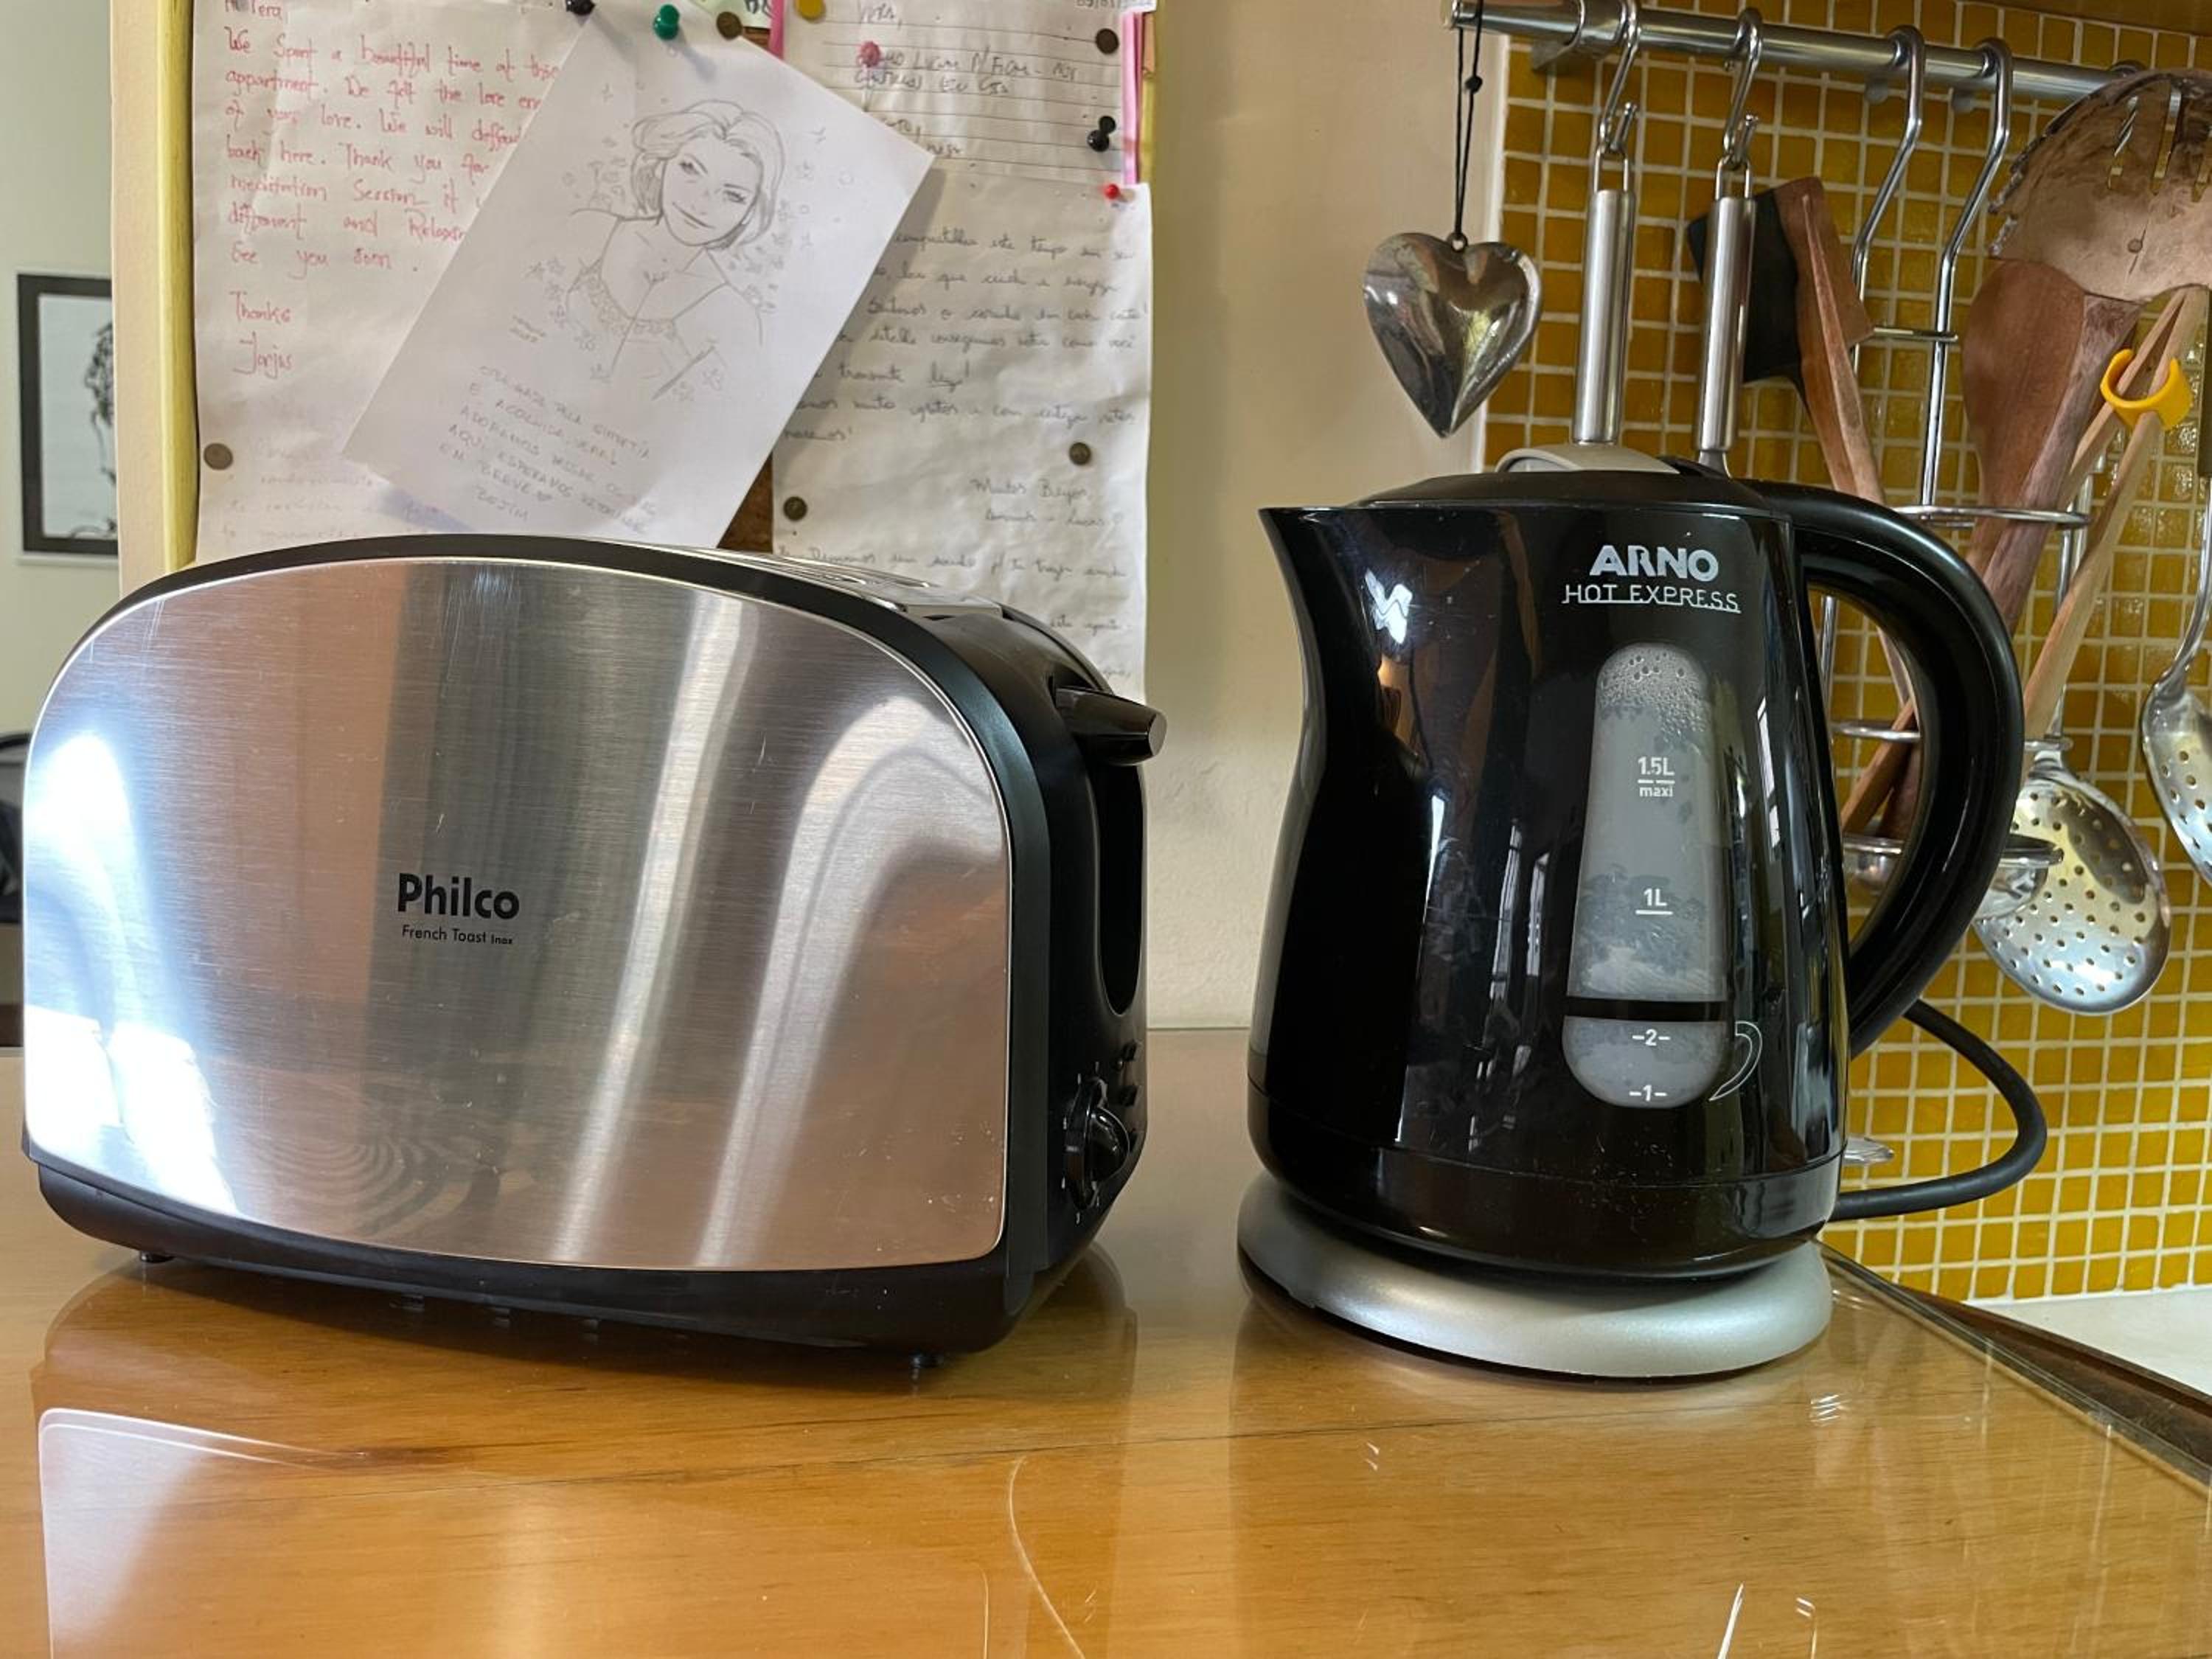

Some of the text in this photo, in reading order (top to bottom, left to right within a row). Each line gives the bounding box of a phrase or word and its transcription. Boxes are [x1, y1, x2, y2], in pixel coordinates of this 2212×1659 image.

[224, 26, 251, 54] We
[448, 46, 481, 75] time
[435, 79, 463, 103] the
[379, 108, 407, 133] We
[338, 142, 394, 170] Thank
[410, 153, 442, 184] you
[288, 249, 330, 279] you
[229, 291, 292, 324] Thanks
[1589, 545, 1719, 582] ARNO
[1562, 585, 1742, 614] HOT EXPRESS
[1639, 785, 1674, 798] maxi
[397, 872, 521, 920] Philco
[1643, 887, 1669, 907] 1L
[401, 924, 448, 942] French
[452, 928, 487, 945] Toast
